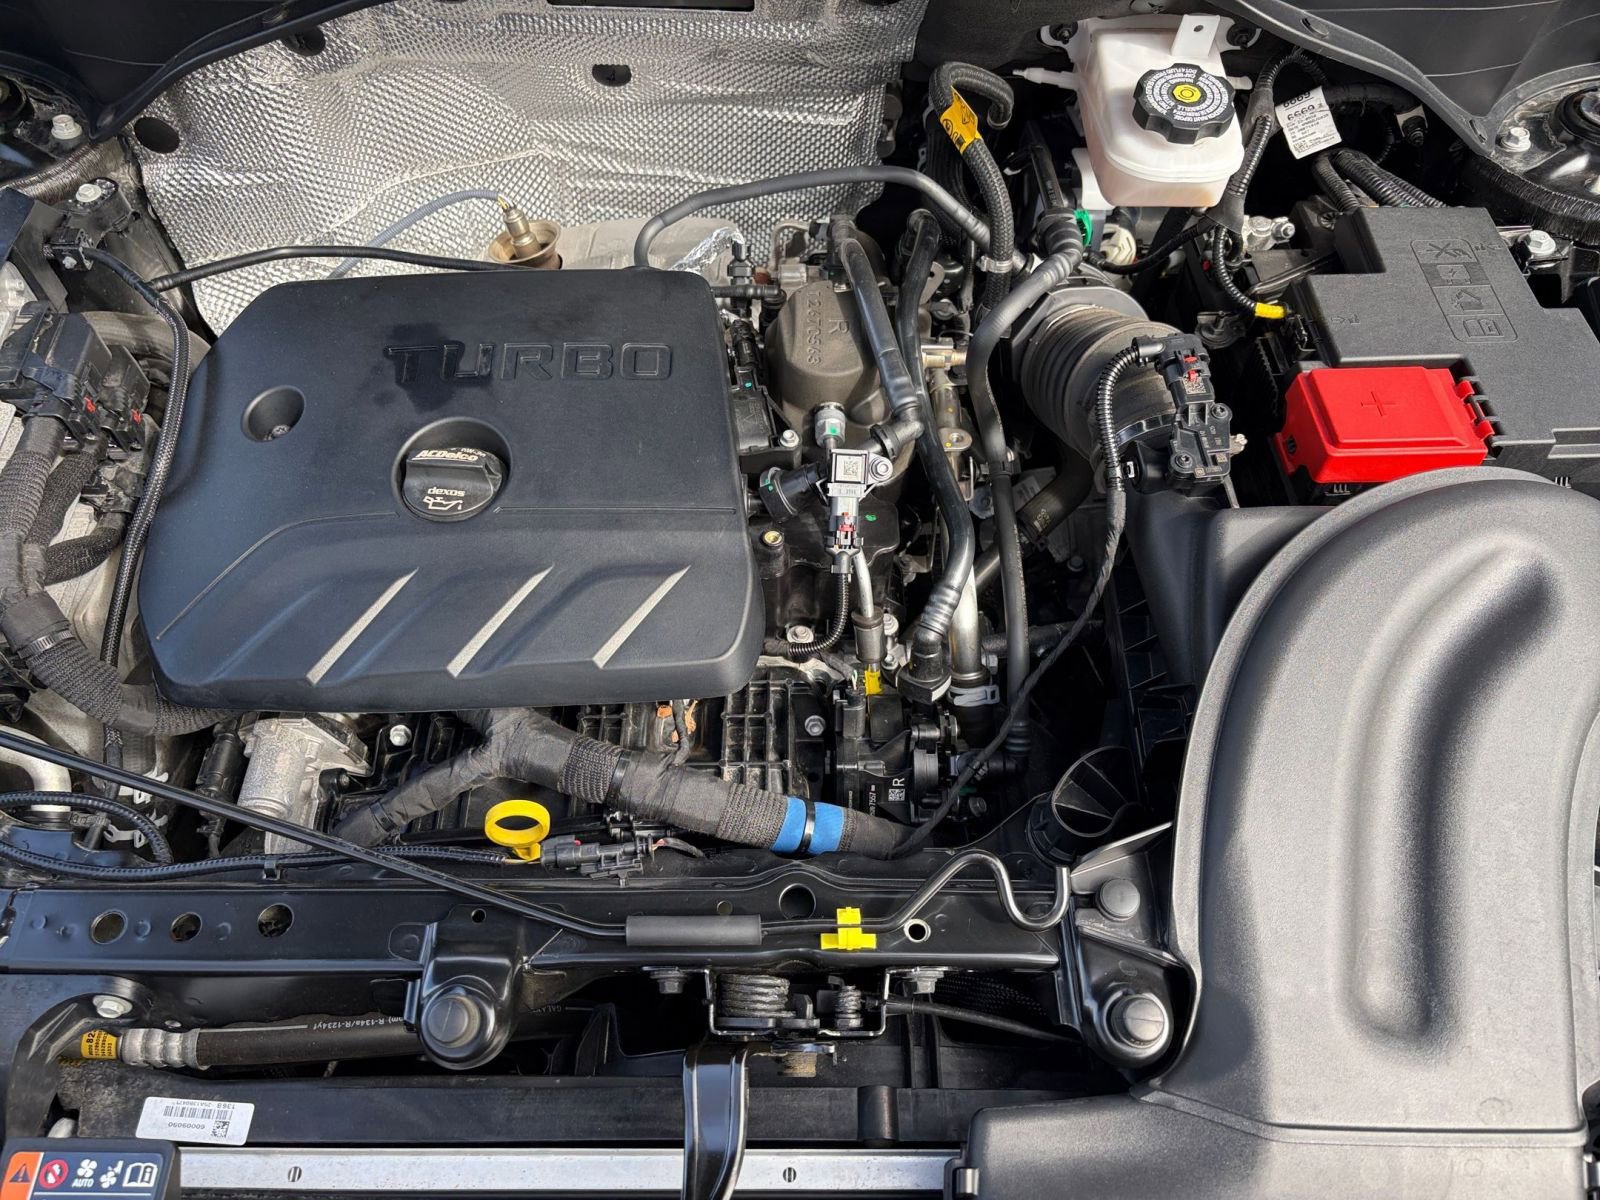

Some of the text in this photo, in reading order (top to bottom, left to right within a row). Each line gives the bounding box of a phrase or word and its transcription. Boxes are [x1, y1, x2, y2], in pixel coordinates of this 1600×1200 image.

[388, 342, 672, 382] TURBO
[415, 449, 479, 461] ACDelco
[427, 486, 466, 497] dexos
[892, 778, 905, 787] R
[71, 1178, 94, 1188] AUTO
